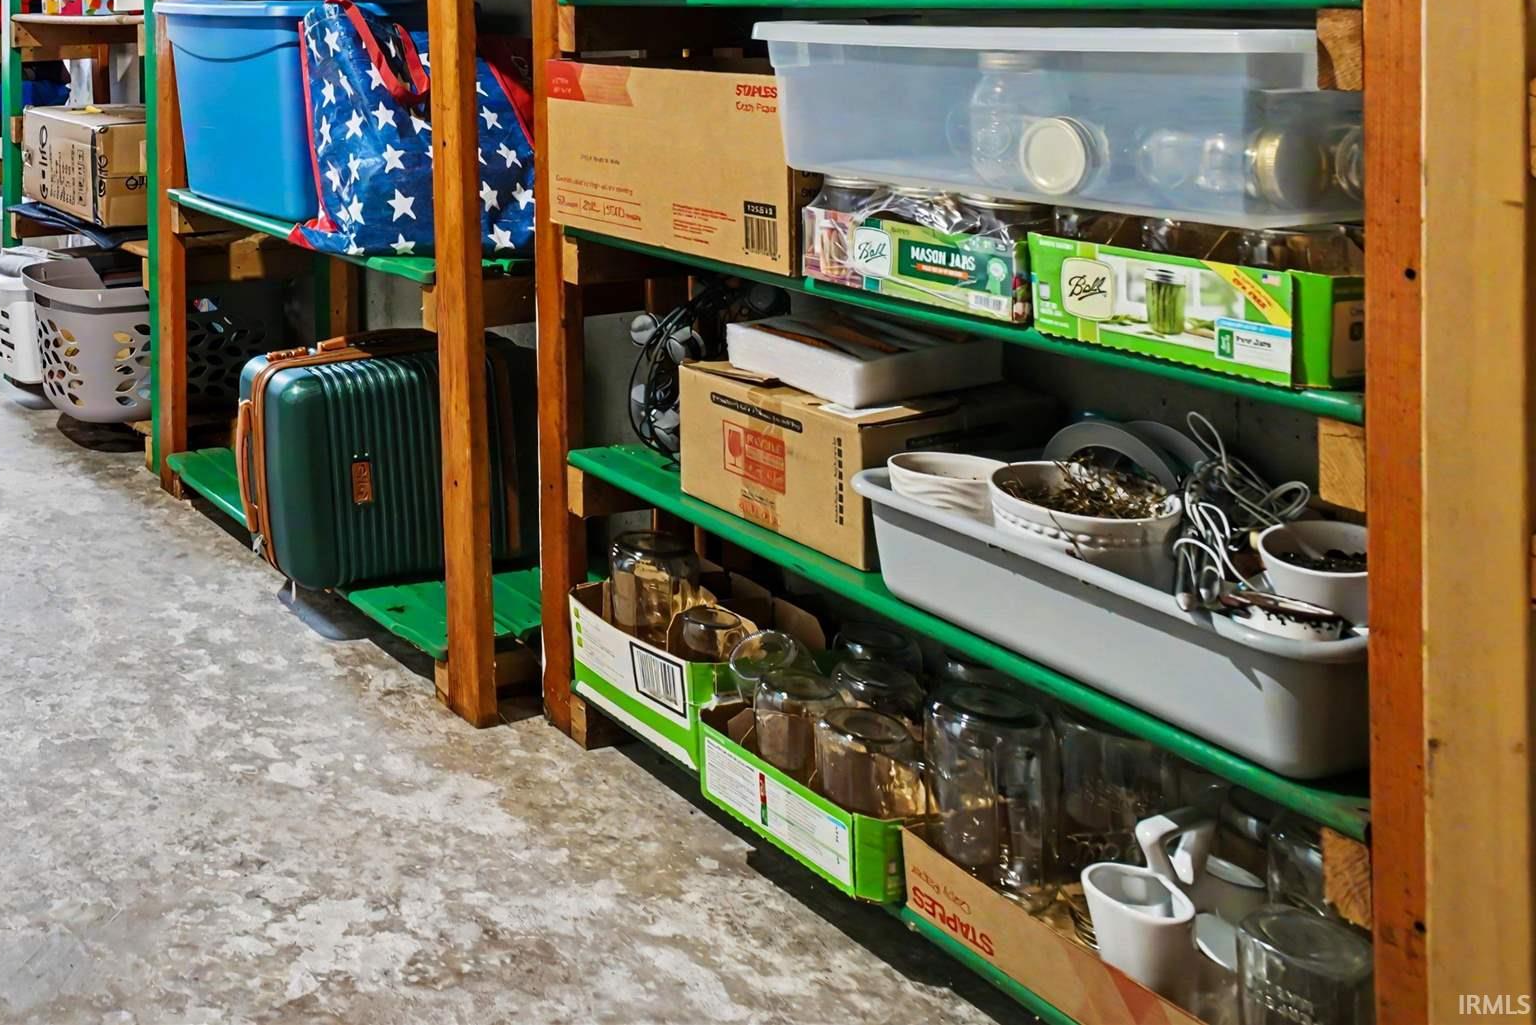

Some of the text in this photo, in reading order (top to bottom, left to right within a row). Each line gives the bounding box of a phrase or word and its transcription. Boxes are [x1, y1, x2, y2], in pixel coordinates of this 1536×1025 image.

[735, 84, 778, 99] STAPLES
[857, 241, 887, 263] Ball
[910, 245, 947, 265] MASON
[948, 251, 977, 272] JARS
[1068, 275, 1107, 301] Ball
[911, 885, 995, 957] STAPLES
